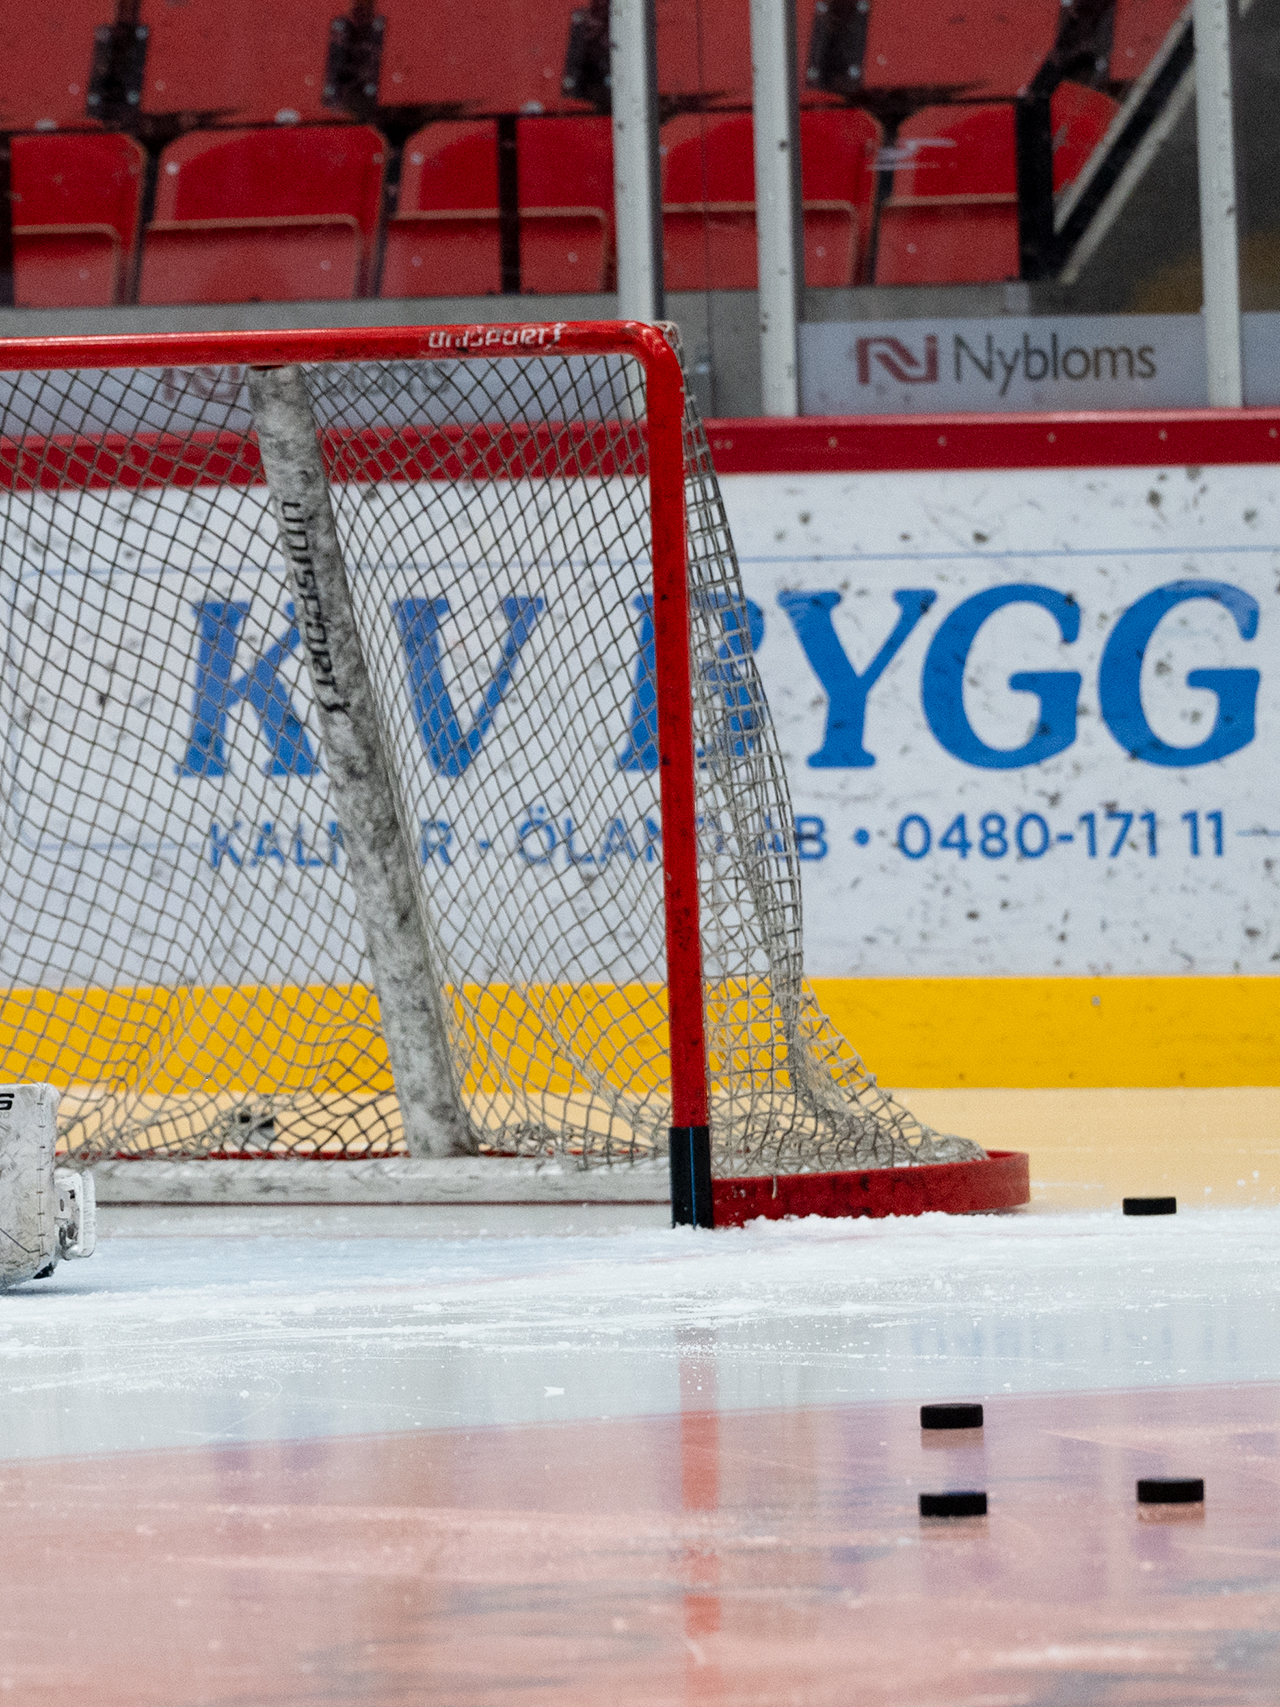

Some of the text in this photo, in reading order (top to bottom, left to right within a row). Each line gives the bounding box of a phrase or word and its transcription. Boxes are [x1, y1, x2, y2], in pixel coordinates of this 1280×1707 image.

[953, 331, 1157, 397] Nybloms
[615, 579, 1262, 773] BYGG
[210, 820, 452, 869] KALR
[897, 812, 1158, 861] 0480-171
[1181, 810, 1224, 860] 11
